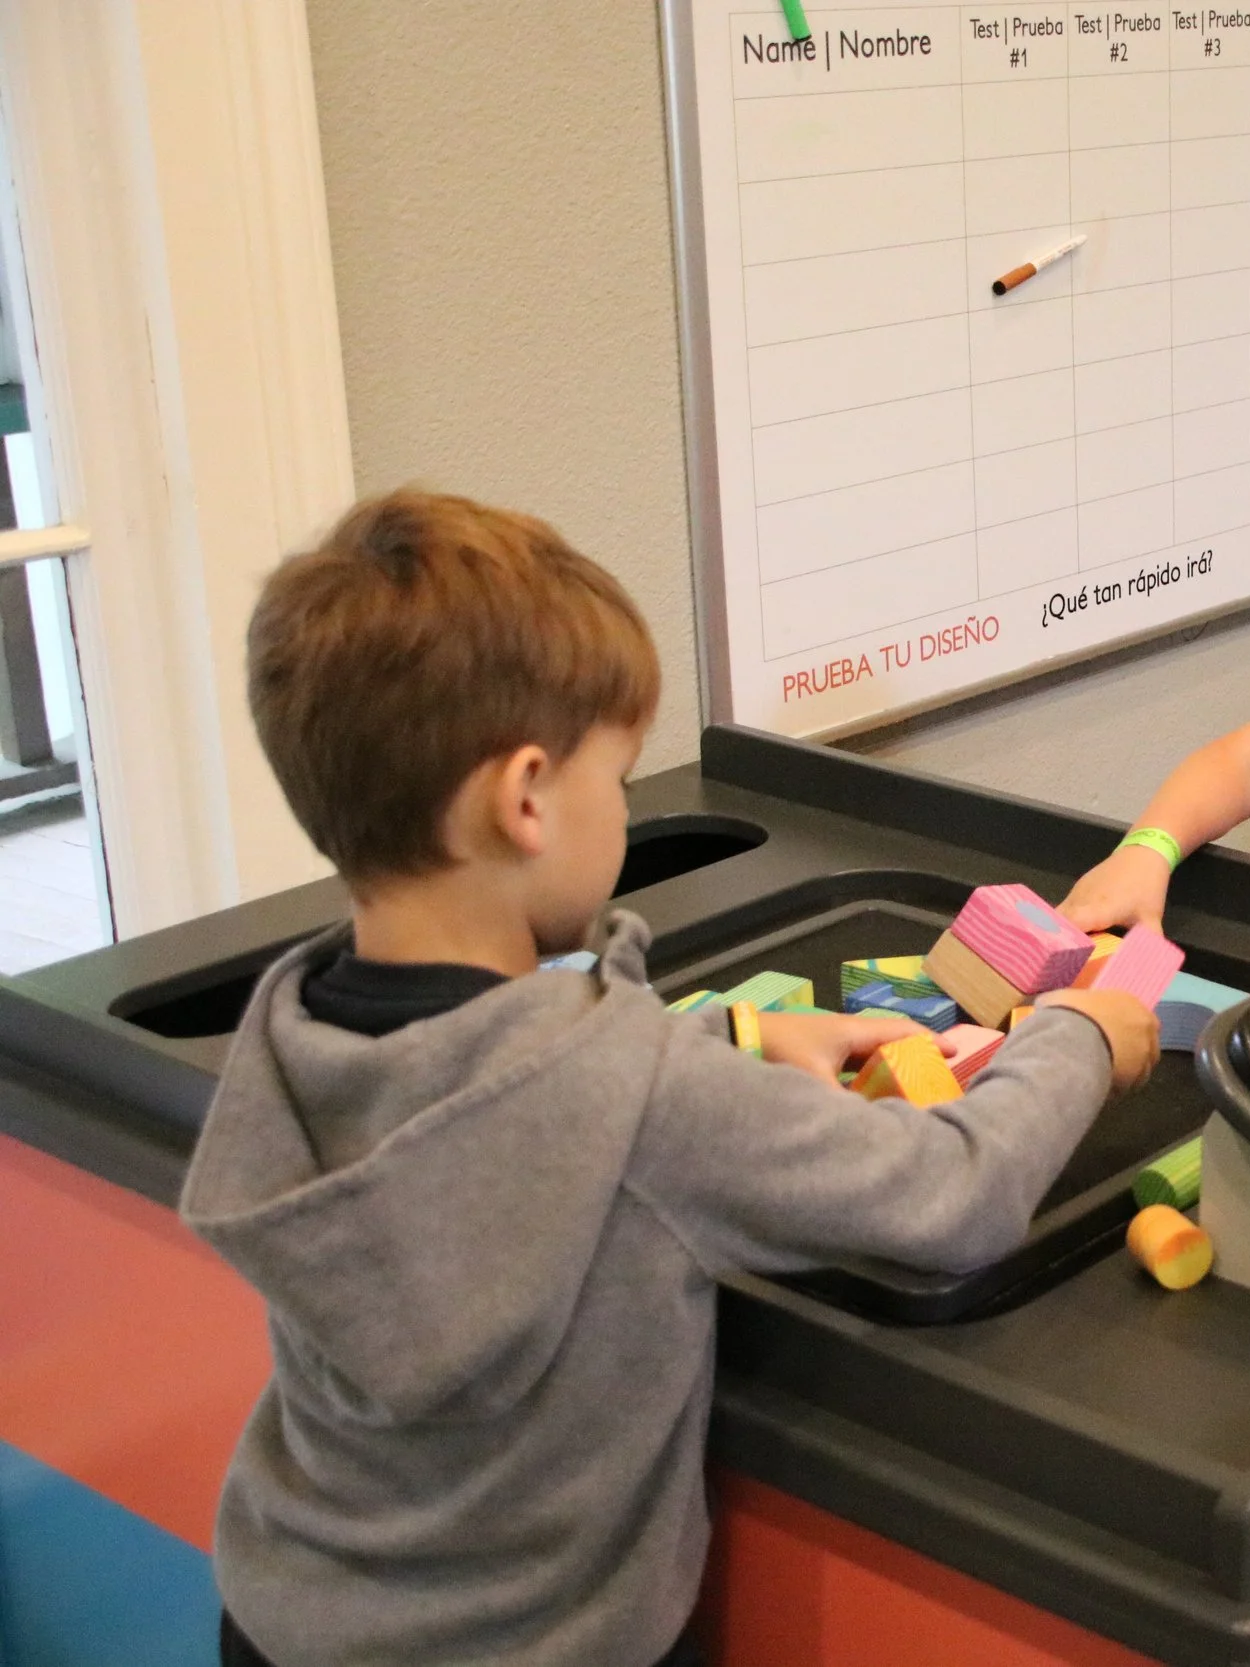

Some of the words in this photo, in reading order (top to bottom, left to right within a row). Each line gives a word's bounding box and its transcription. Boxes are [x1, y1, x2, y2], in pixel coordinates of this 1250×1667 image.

[970, 18, 1000, 39] Test
[1013, 16, 1064, 38] Prueba
[1075, 15, 1103, 35] Test
[1114, 13, 1161, 34] Prueba
[1172, 11, 1198, 30] Test
[743, 34, 816, 65] Name
[840, 28, 932, 60] Nombre
[1110, 42, 1129, 62] #2
[1204, 38, 1221, 57] #3
[1009, 48, 1028, 68] #1
[1041, 586, 1088, 628] ¿Qué
[1094, 583, 1122, 605] tan
[1127, 562, 1181, 597] rápido
[1187, 549, 1213, 579] irá?
[783, 653, 873, 702] PRUEBA
[880, 640, 911, 673] TU
[920, 615, 1000, 661] DISEÑO
